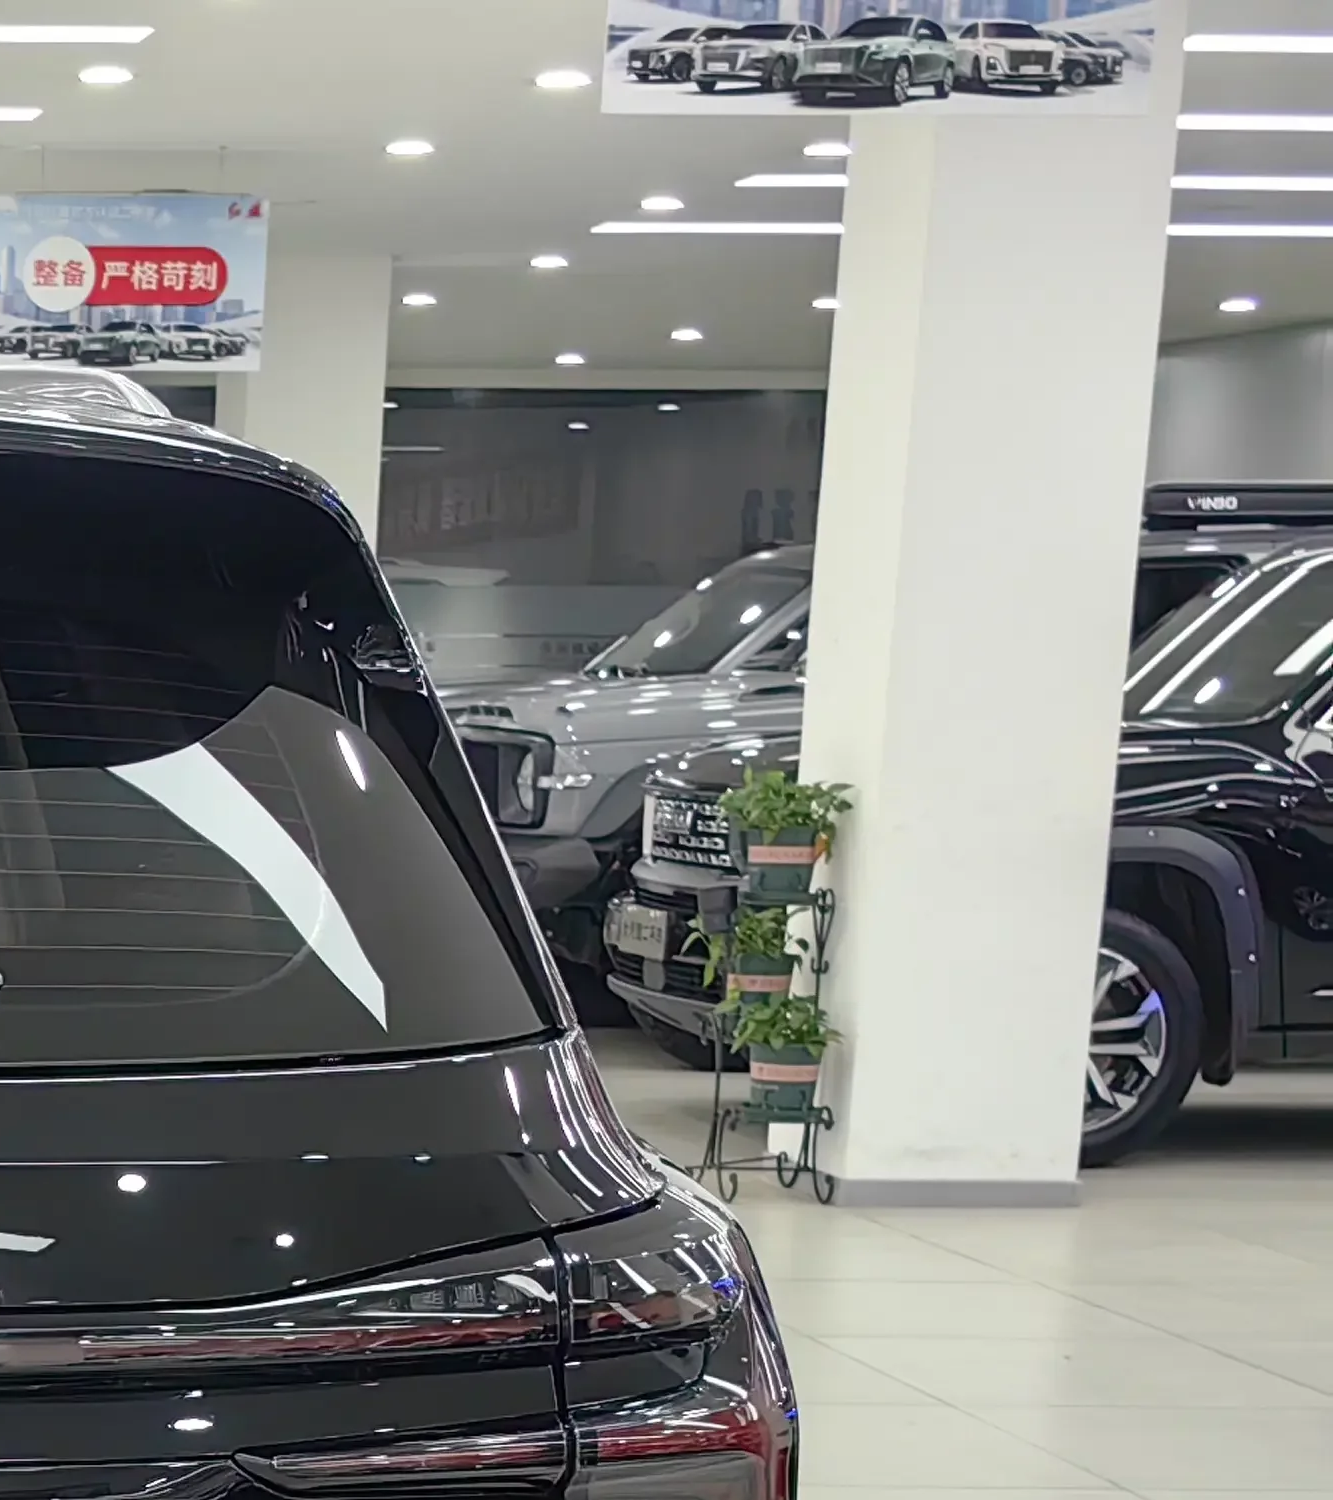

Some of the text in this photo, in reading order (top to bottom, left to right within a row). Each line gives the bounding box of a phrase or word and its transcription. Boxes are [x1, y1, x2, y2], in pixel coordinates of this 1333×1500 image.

[33, 260, 218, 290] 整备 严格苛刻
